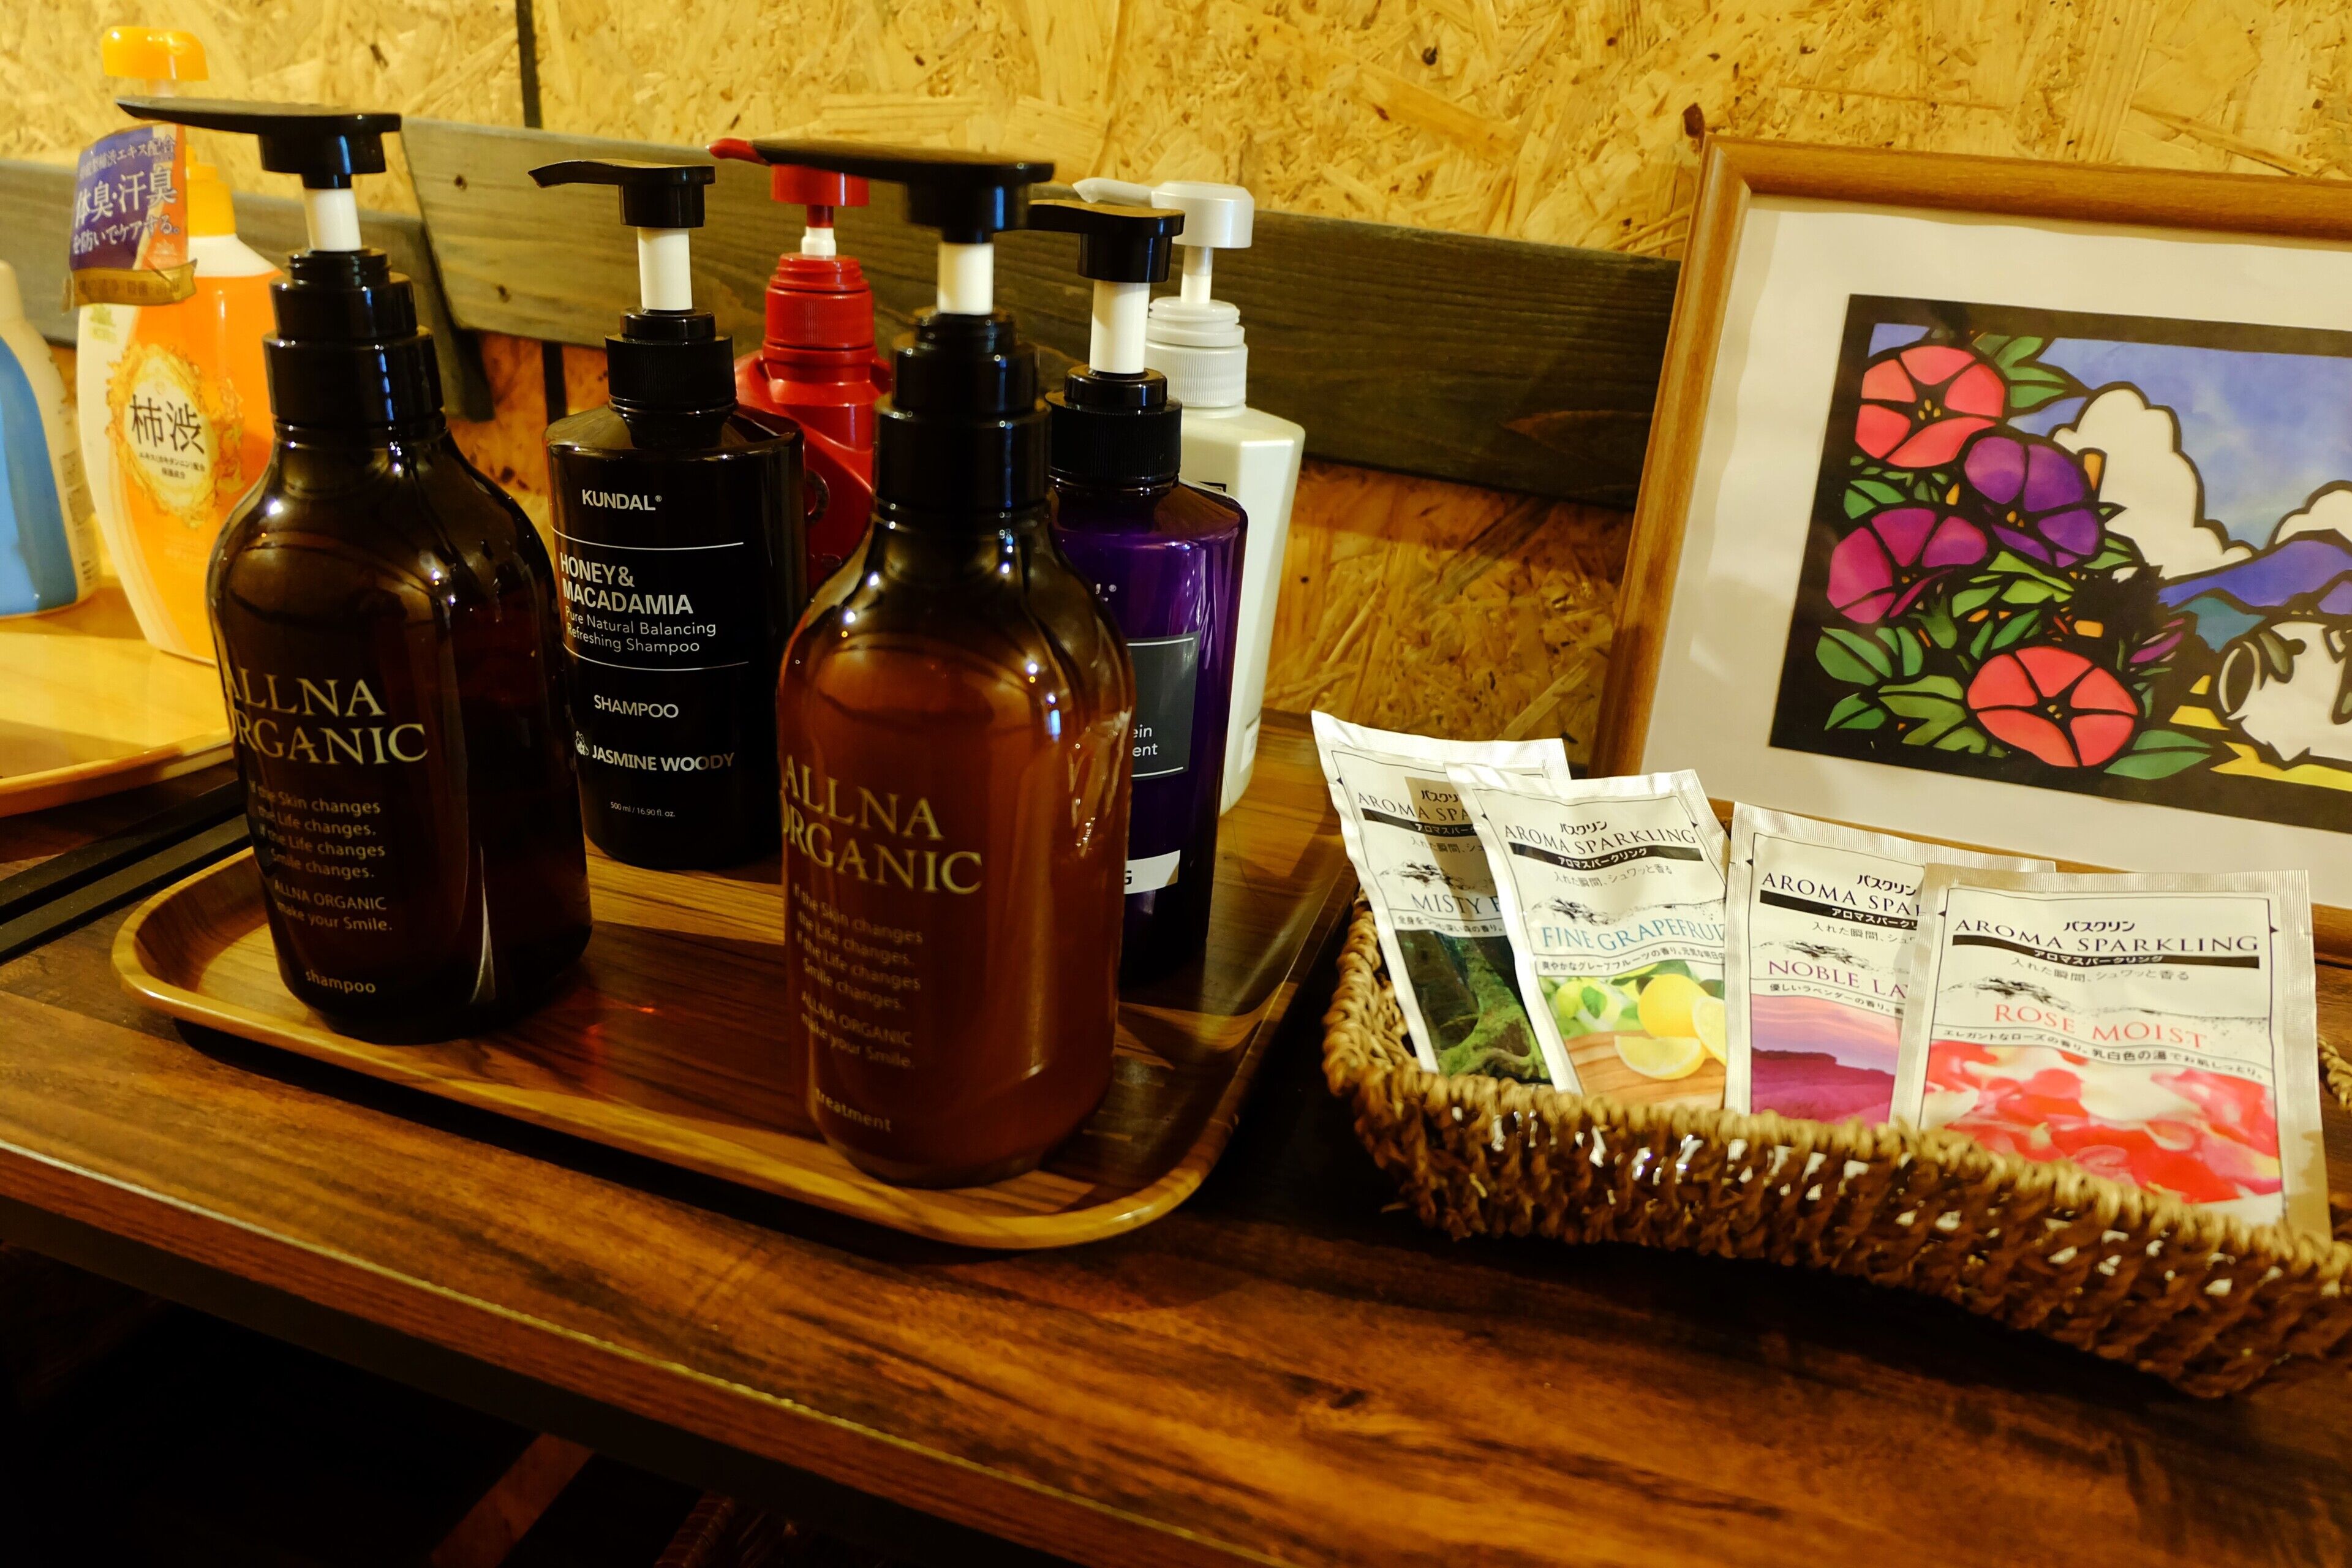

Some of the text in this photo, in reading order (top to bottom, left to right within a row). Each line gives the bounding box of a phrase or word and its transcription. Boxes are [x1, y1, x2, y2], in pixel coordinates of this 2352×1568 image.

[75, 165, 178, 229] 体臭・汗臭
[130, 394, 205, 455] 柿渋
[562, 578, 693, 615] MACADAMIA
[565, 605, 716, 636] Pure Natural Balancing
[567, 622, 699, 656] Refreshing Shampoo
[594, 694, 679, 718] SHAMPOO
[592, 745, 734, 772] JASMINE WOODY
[311, 797, 381, 818] changes
[610, 801, 622, 811] 500
[636, 807, 655, 816] 16.90
[784, 754, 945, 841] ALLNA
[1358, 792, 1431, 820] AROMA
[304, 818, 376, 839] changes.
[1505, 824, 1696, 855] AROMA SPARKLING
[1559, 821, 1607, 835] バスクリン
[317, 842, 386, 861] changes
[1558, 846, 1647, 869] アロマスパークリング
[306, 861, 375, 881] changes.
[1554, 864, 1673, 888] 入れた瞬間、シュワッと香る
[274, 880, 387, 910] ALLNA ORGANIC
[1762, 872, 1857, 906] AROMA
[1857, 874, 1917, 896] バスクリン
[1411, 893, 1482, 914] MISTY
[309, 913, 338, 926] your
[343, 916, 392, 930] Smile.
[852, 918, 924, 946] changes
[2064, 921, 2135, 932] バスクリン
[1541, 926, 1594, 949] FINE
[1954, 919, 2259, 953] AROMA SPARKLING
[2011, 956, 2190, 983] 入れた瞬間、シュワッと香る
[2034, 949, 2165, 966] アロマスパークリング
[305, 969, 376, 994] shampoo
[850, 963, 921, 991] changes
[1769, 960, 1860, 989] NOBLE
[839, 1014, 913, 1047] ORGANIC
[1994, 1004, 2207, 1048] ROSE MOIST
[830, 1034, 860, 1055] your
[815, 1086, 891, 1132] treatment
